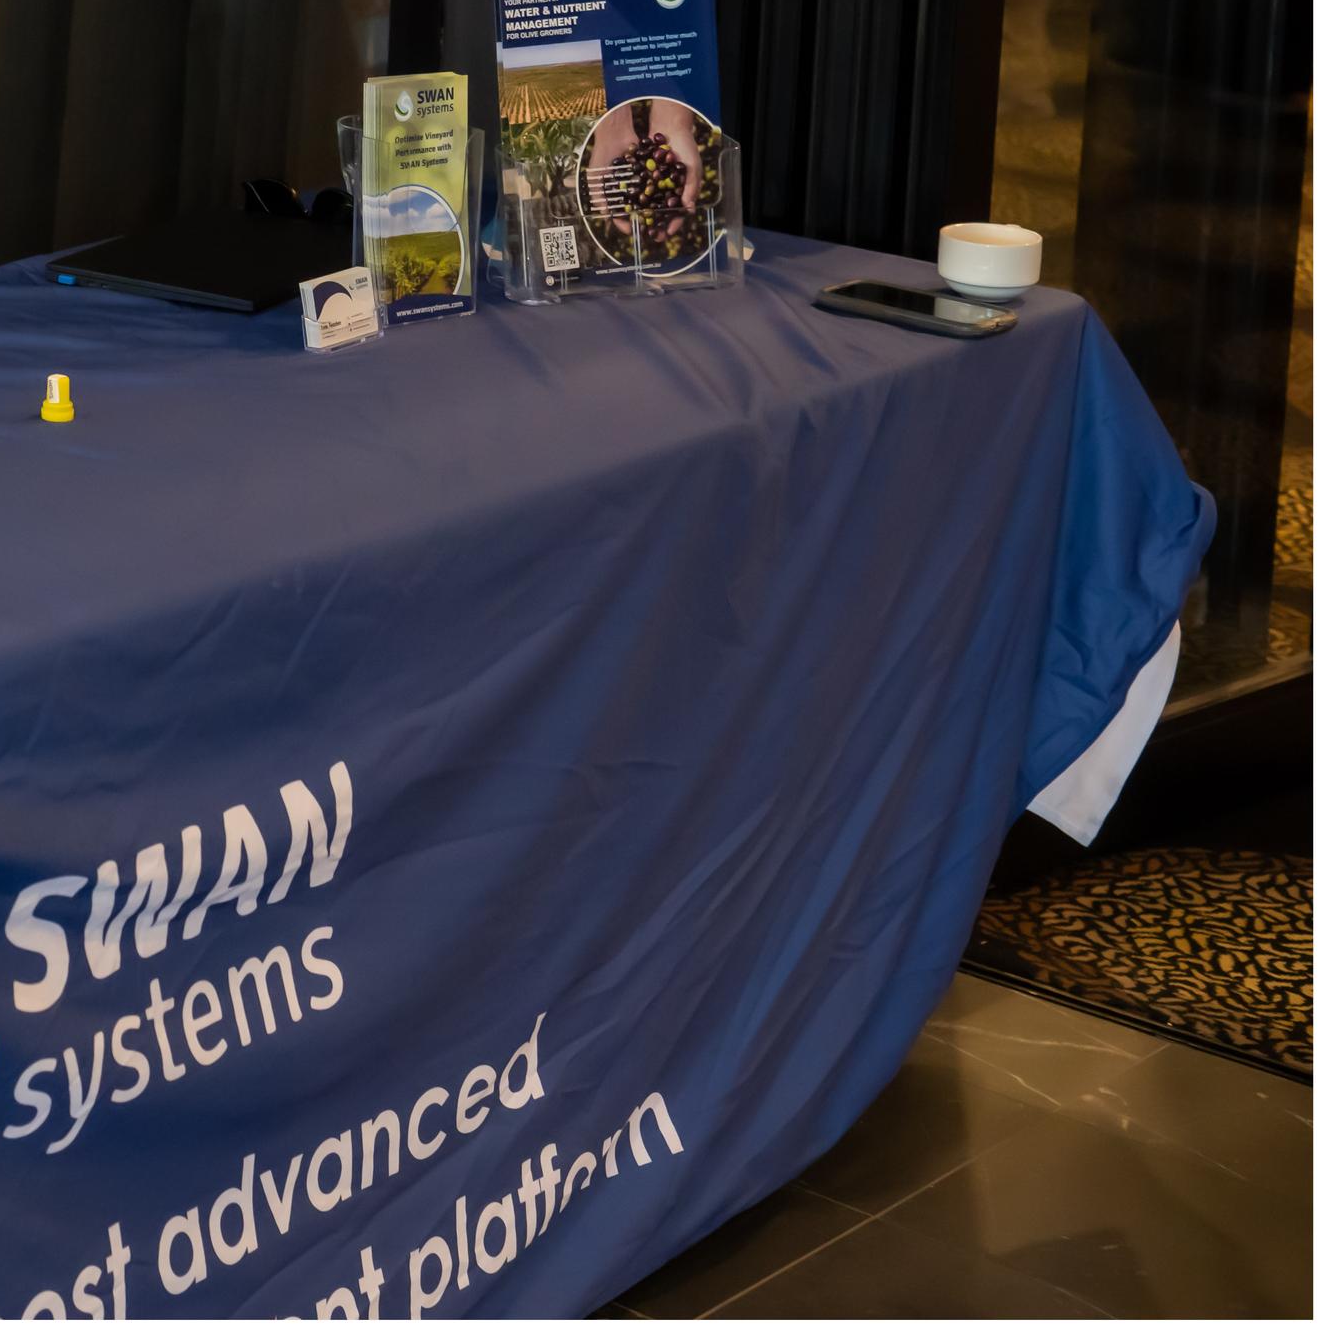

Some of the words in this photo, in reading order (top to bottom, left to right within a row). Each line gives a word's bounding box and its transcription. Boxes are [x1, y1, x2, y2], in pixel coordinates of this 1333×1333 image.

[504, 0, 522, 7] YOUR
[504, 7, 540, 19] WATER
[542, 6, 551, 15] &
[553, 0, 607, 14] NUTRIENT
[505, 16, 578, 32] MANAGEMENT
[520, 30, 539, 39] OLIVE
[539, 27, 573, 37] GROWERS
[417, 87, 454, 105] SWAN
[416, 103, 454, 119] systems
[424, 129, 454, 141] Vineyard
[436, 142, 452, 152] with
[421, 157, 449, 169] Systems
[4, 760, 354, 1013] SWAN
[2, 924, 344, 1155] systems
[157, 1011, 548, 1296] advanced
